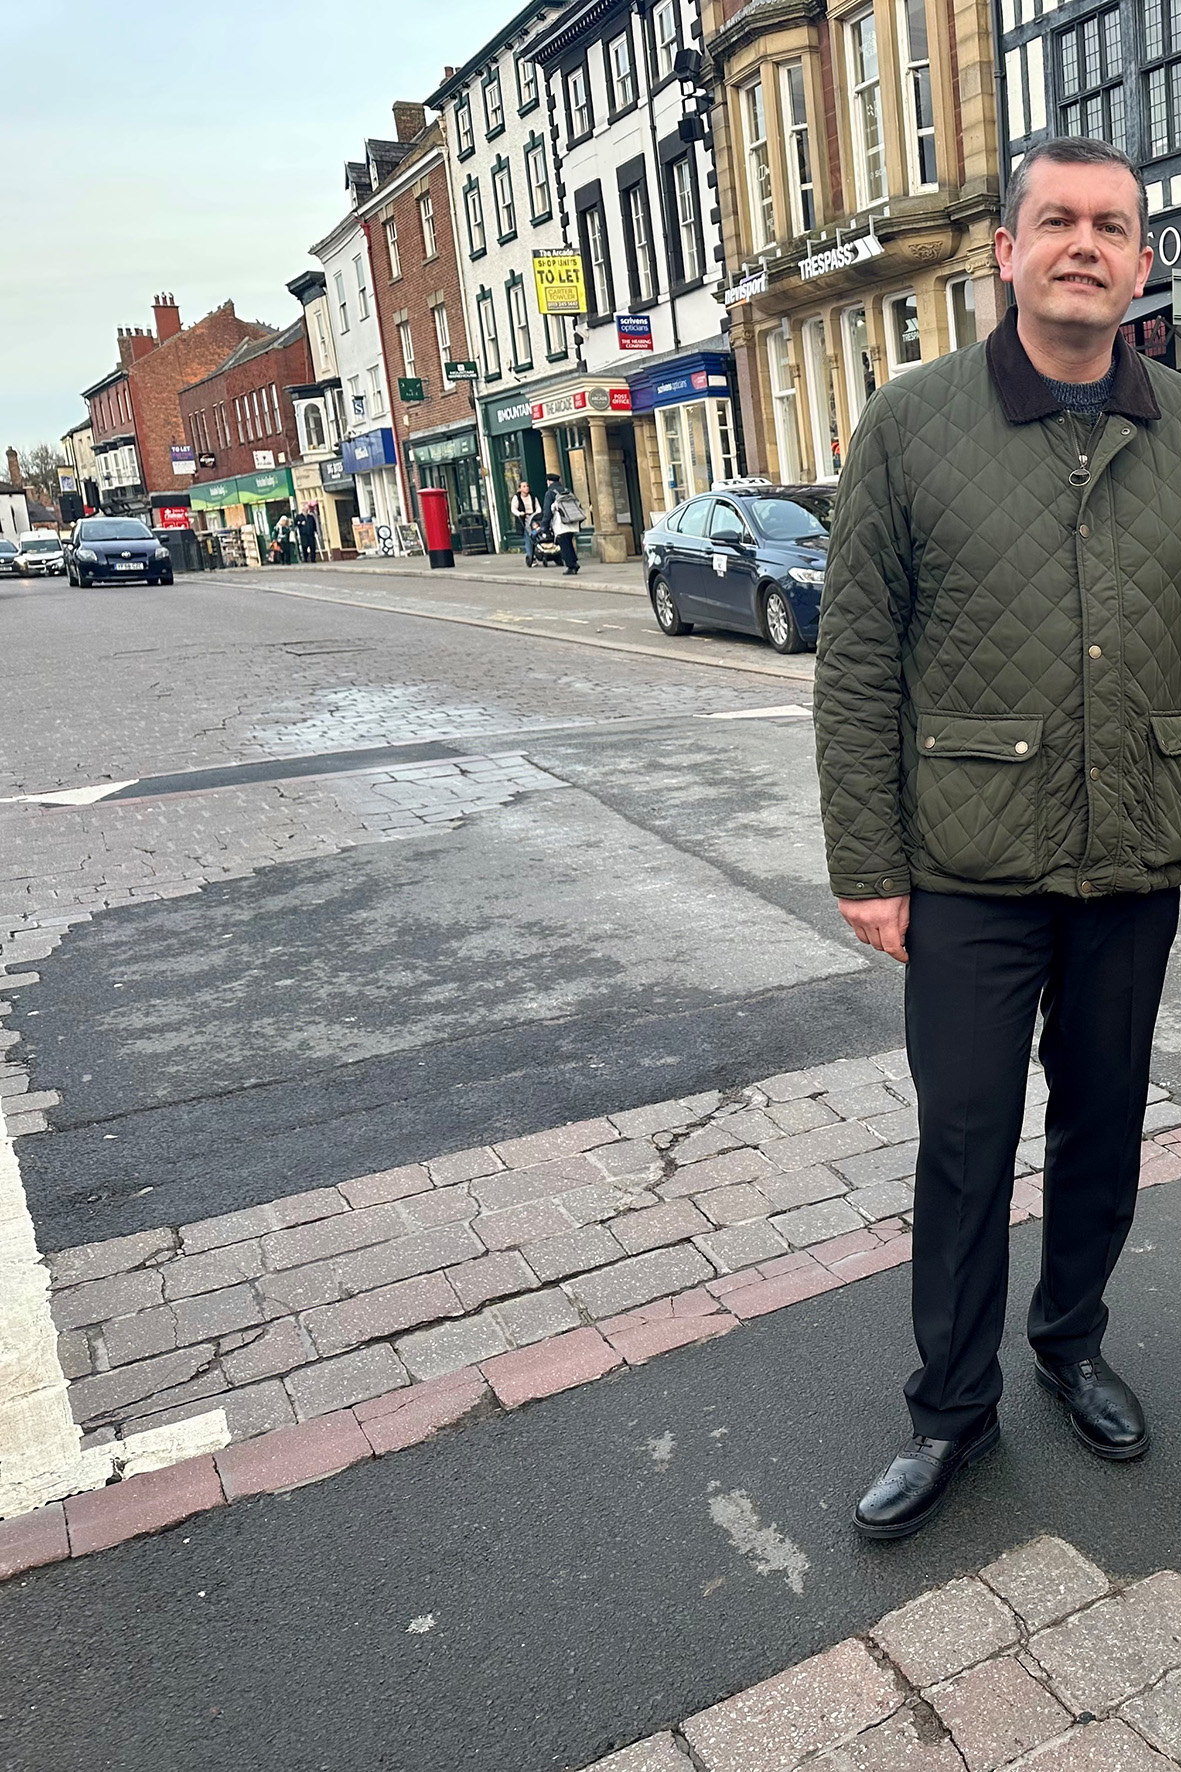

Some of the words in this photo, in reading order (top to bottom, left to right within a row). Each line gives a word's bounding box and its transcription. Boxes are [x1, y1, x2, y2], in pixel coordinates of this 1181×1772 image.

[537, 259, 556, 267] SHOP
[558, 259, 577, 267] UNITS
[798, 243, 853, 281] TRESPASS
[537, 269, 555, 284] TO
[558, 268, 580, 284] LET
[724, 275, 767, 303] nevisport
[620, 317, 648, 325] scrivens
[621, 324, 649, 333] opticians
